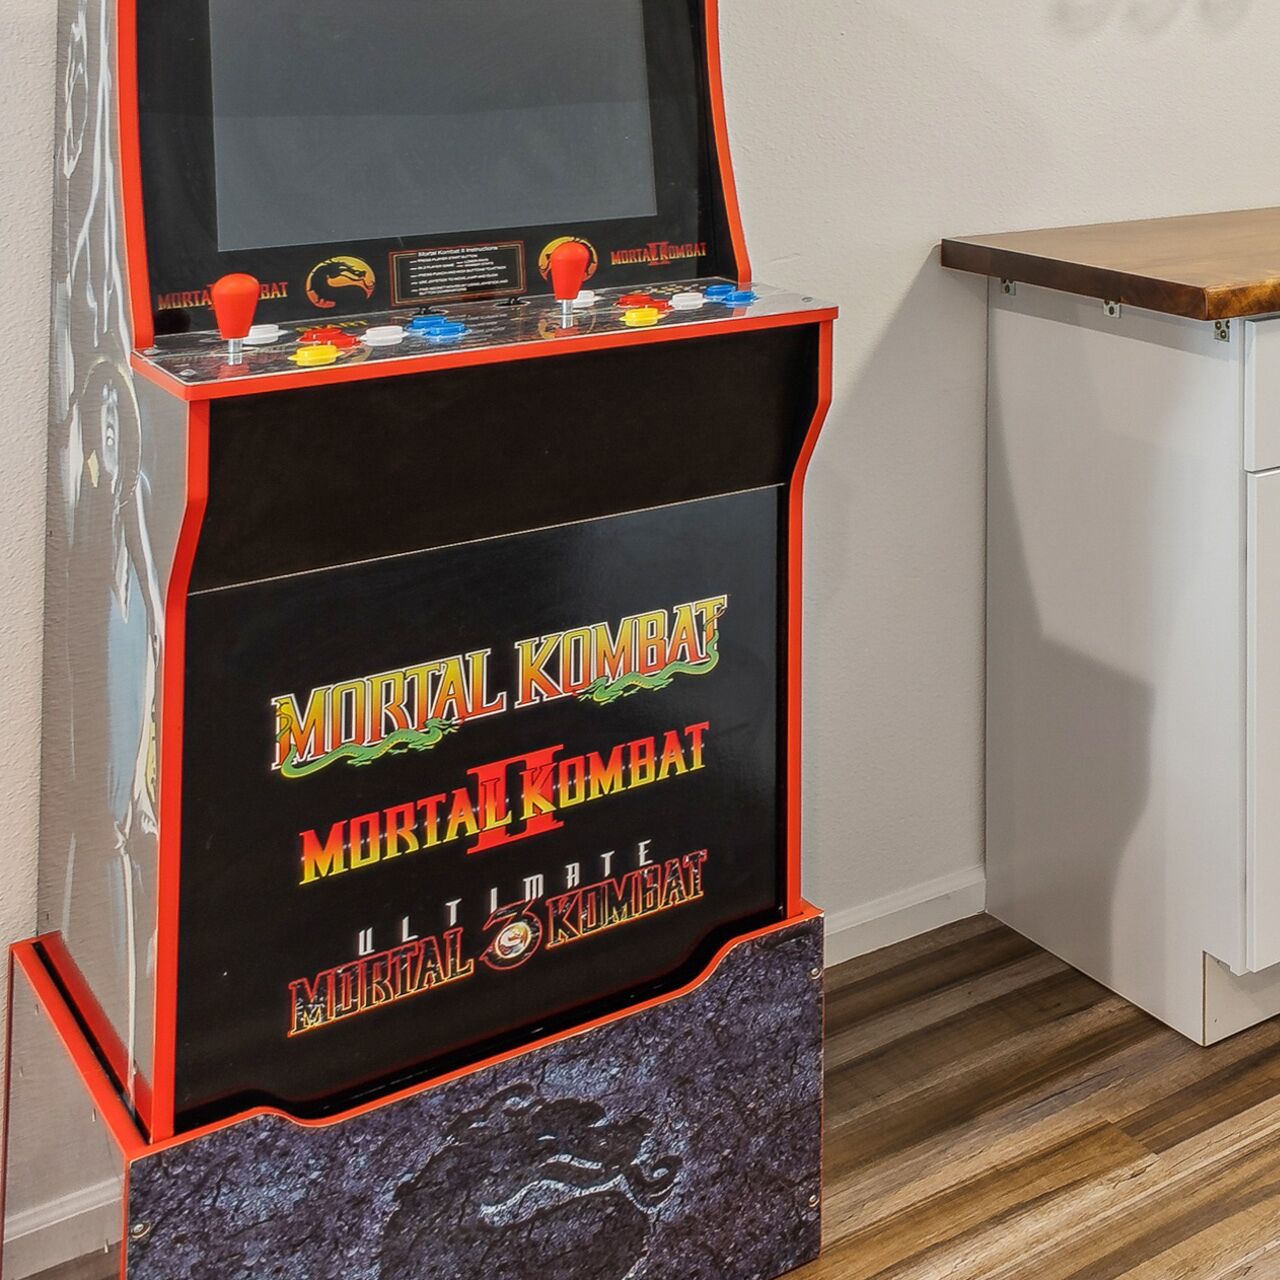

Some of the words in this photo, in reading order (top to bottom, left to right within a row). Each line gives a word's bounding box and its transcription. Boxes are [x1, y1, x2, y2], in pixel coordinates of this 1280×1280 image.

[158, 290, 212, 311] MORTA
[611, 247, 659, 265] MORTAL
[660, 242, 707, 260] KOMBAT
[272, 648, 506, 771] MORTAL
[514, 594, 727, 709] KOMBAT
[299, 777, 511, 885] MORTAL
[520, 721, 710, 820] KOMBAT
[287, 926, 475, 1037] MORTAL
[545, 849, 707, 950] KOMBAT
[358, 839, 654, 956] ULTIMATE
